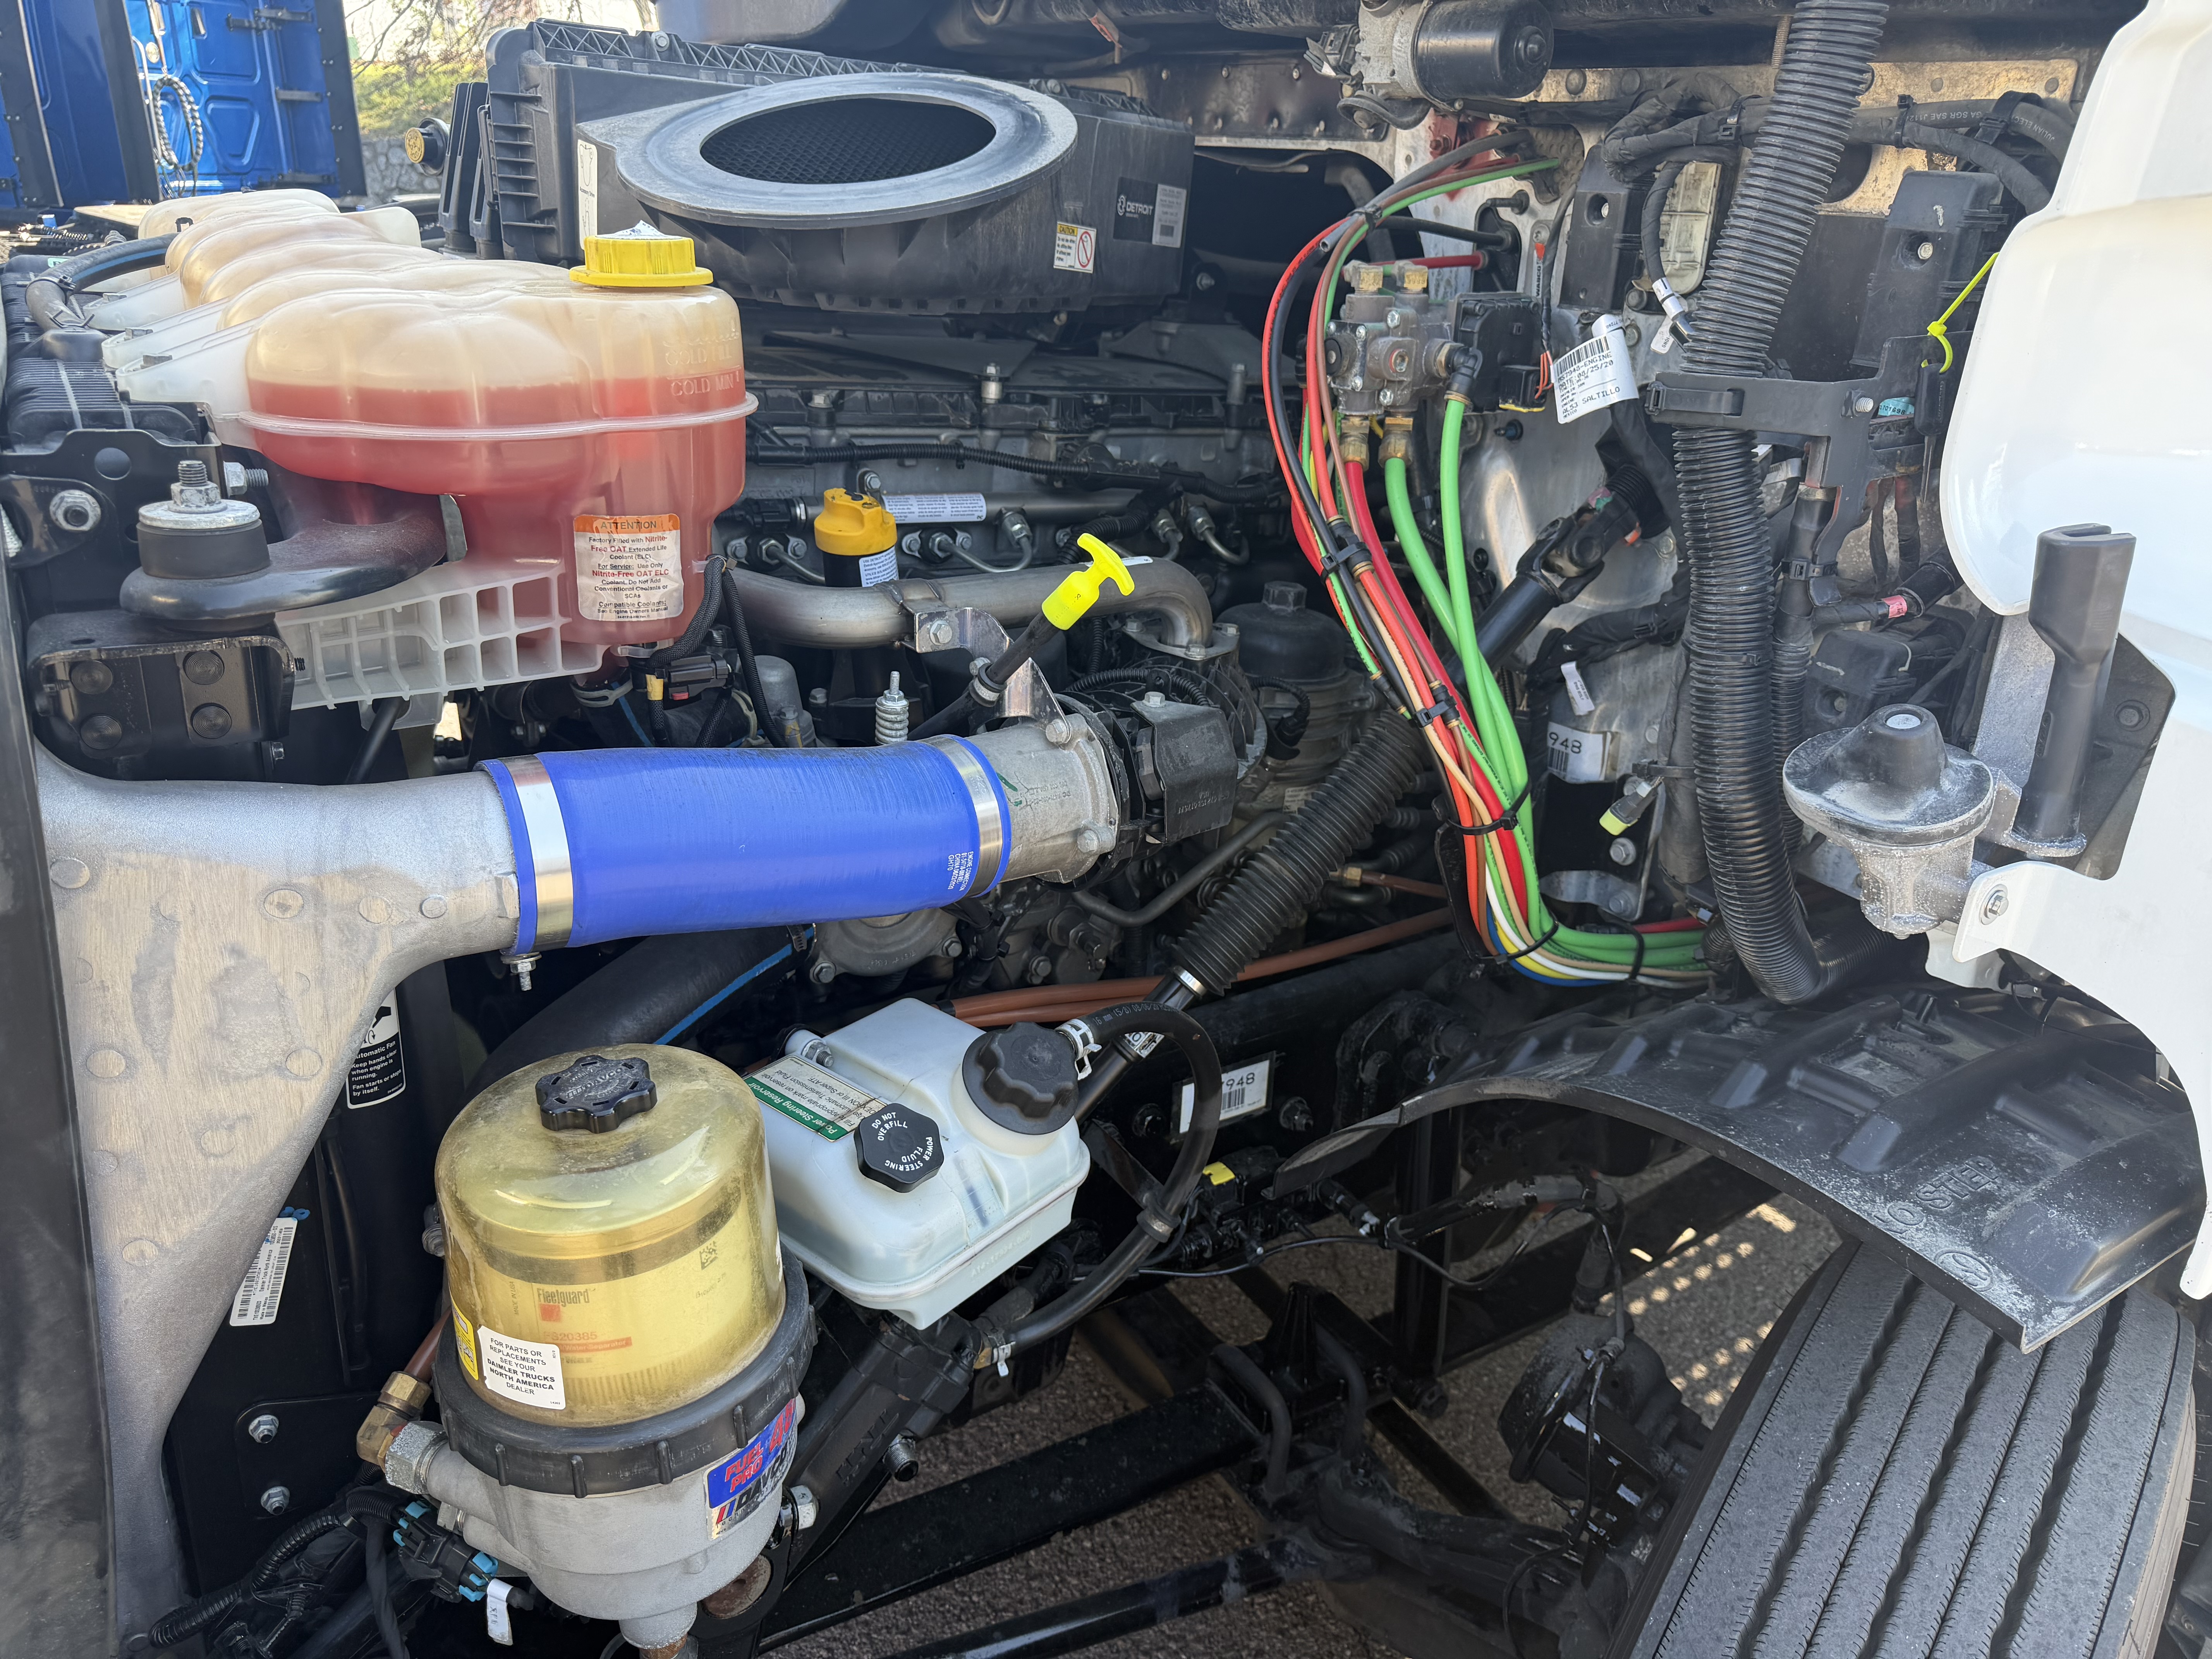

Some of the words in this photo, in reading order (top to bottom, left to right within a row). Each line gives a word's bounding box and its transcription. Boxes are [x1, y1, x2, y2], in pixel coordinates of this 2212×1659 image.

[1126, 202, 1154, 215] DETROIT
[671, 378, 711, 396] COLD
[1582, 387, 1620, 404] SALTILLO
[601, 521, 656, 529] ATTENTION
[1549, 732, 1582, 754] 948
[1113, 1006, 1131, 1017] (5/8)
[356, 1046, 386, 1059] utomatic
[386, 1041, 395, 1049] Fan
[369, 1056, 386, 1065] hands
[386, 1049, 397, 1058] clear
[370, 1062, 388, 1072] engine
[352, 1073, 378, 1081] running.
[366, 1079, 383, 1087] starts
[390, 1069, 402, 1079] stops
[761, 1072, 784, 1088] reservoir.
[775, 1070, 793, 1082] Fluid
[1222, 1072, 1255, 1090] 948
[749, 1082, 783, 1104] Reservoir
[793, 1080, 825, 1099] Transmission
[793, 1090, 807, 1099] mark
[820, 1083, 837, 1094] Super
[783, 1101, 813, 1121] Steering
[807, 1098, 840, 1117] appropriate
[825, 1096, 852, 1113] Automatic
[853, 1111, 865, 1119] Use
[872, 1118, 881, 1129] DO
[883, 1112, 896, 1122] NOT
[812, 1117, 838, 1134] Power
[878, 1121, 908, 1141] OVERFILL
[902, 1146, 923, 1162] FLUID
[922, 1137, 933, 1161] POWER
[884, 1160, 923, 1171] STEERING
[1916, 1156, 1999, 1209] STEP
[537, 1287, 590, 1307] Fleetguard
[490, 1345, 546, 1365] REPLACEMENTS
[491, 1338, 504, 1348] FOR
[505, 1344, 528, 1355] PARTS
[487, 1358, 518, 1375] DAIMLER
[520, 1371, 555, 1382] TRUCKS
[500, 1357, 512, 1366] SEE
[515, 1362, 536, 1372] YOUR
[490, 1367, 514, 1381] NORTH
[516, 1378, 554, 1390] AMERICA
[507, 1382, 535, 1395] DEALER
[725, 1441, 764, 1482] FUEL
[730, 1455, 763, 1493] PRO
[735, 1442, 788, 1512] DAVCO
